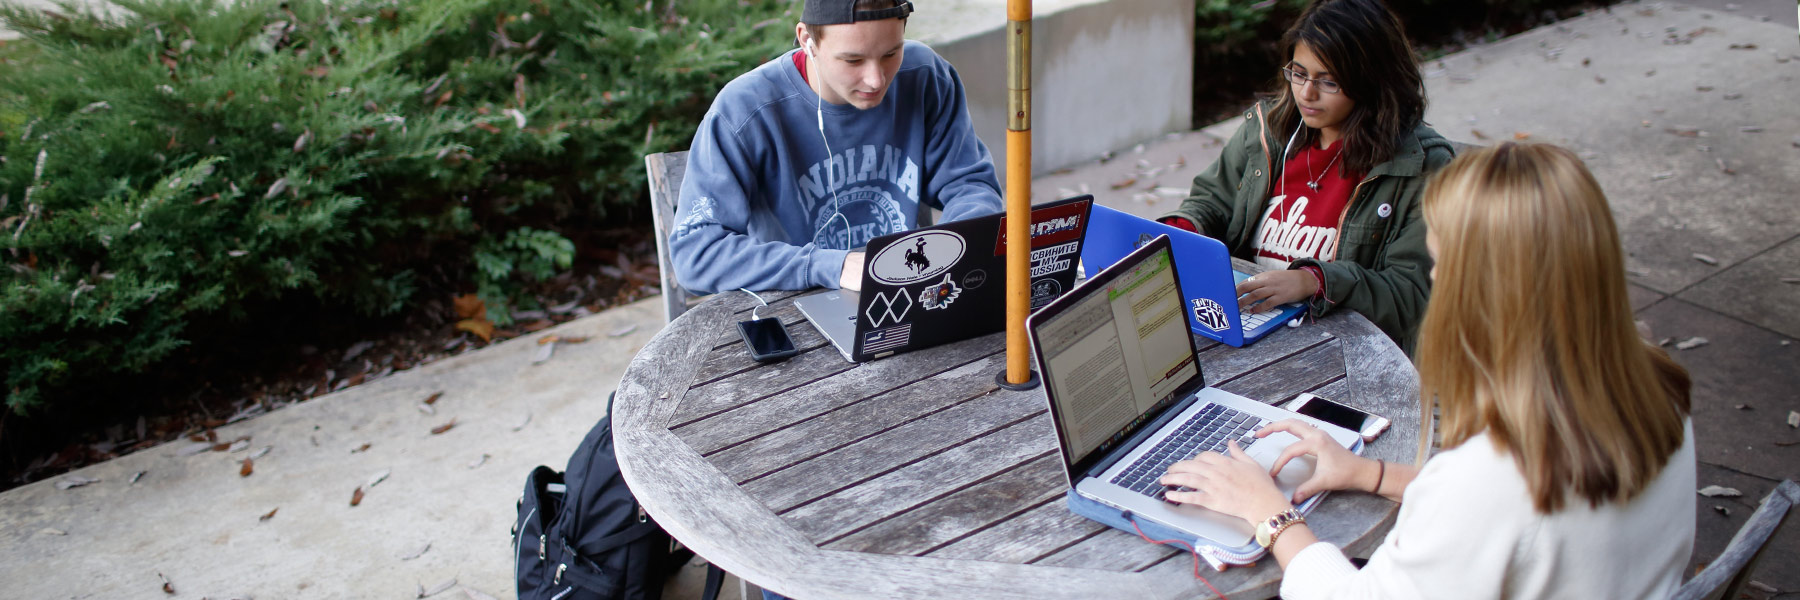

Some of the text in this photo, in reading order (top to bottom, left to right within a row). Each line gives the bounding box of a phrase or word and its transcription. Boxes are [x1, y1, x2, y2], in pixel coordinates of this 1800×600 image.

[874, 193, 897, 218] WHITE
[836, 222, 876, 249] FTK
[1030, 243, 1077, 261] СВИНИТЕ
[1041, 256, 1057, 267] MY
